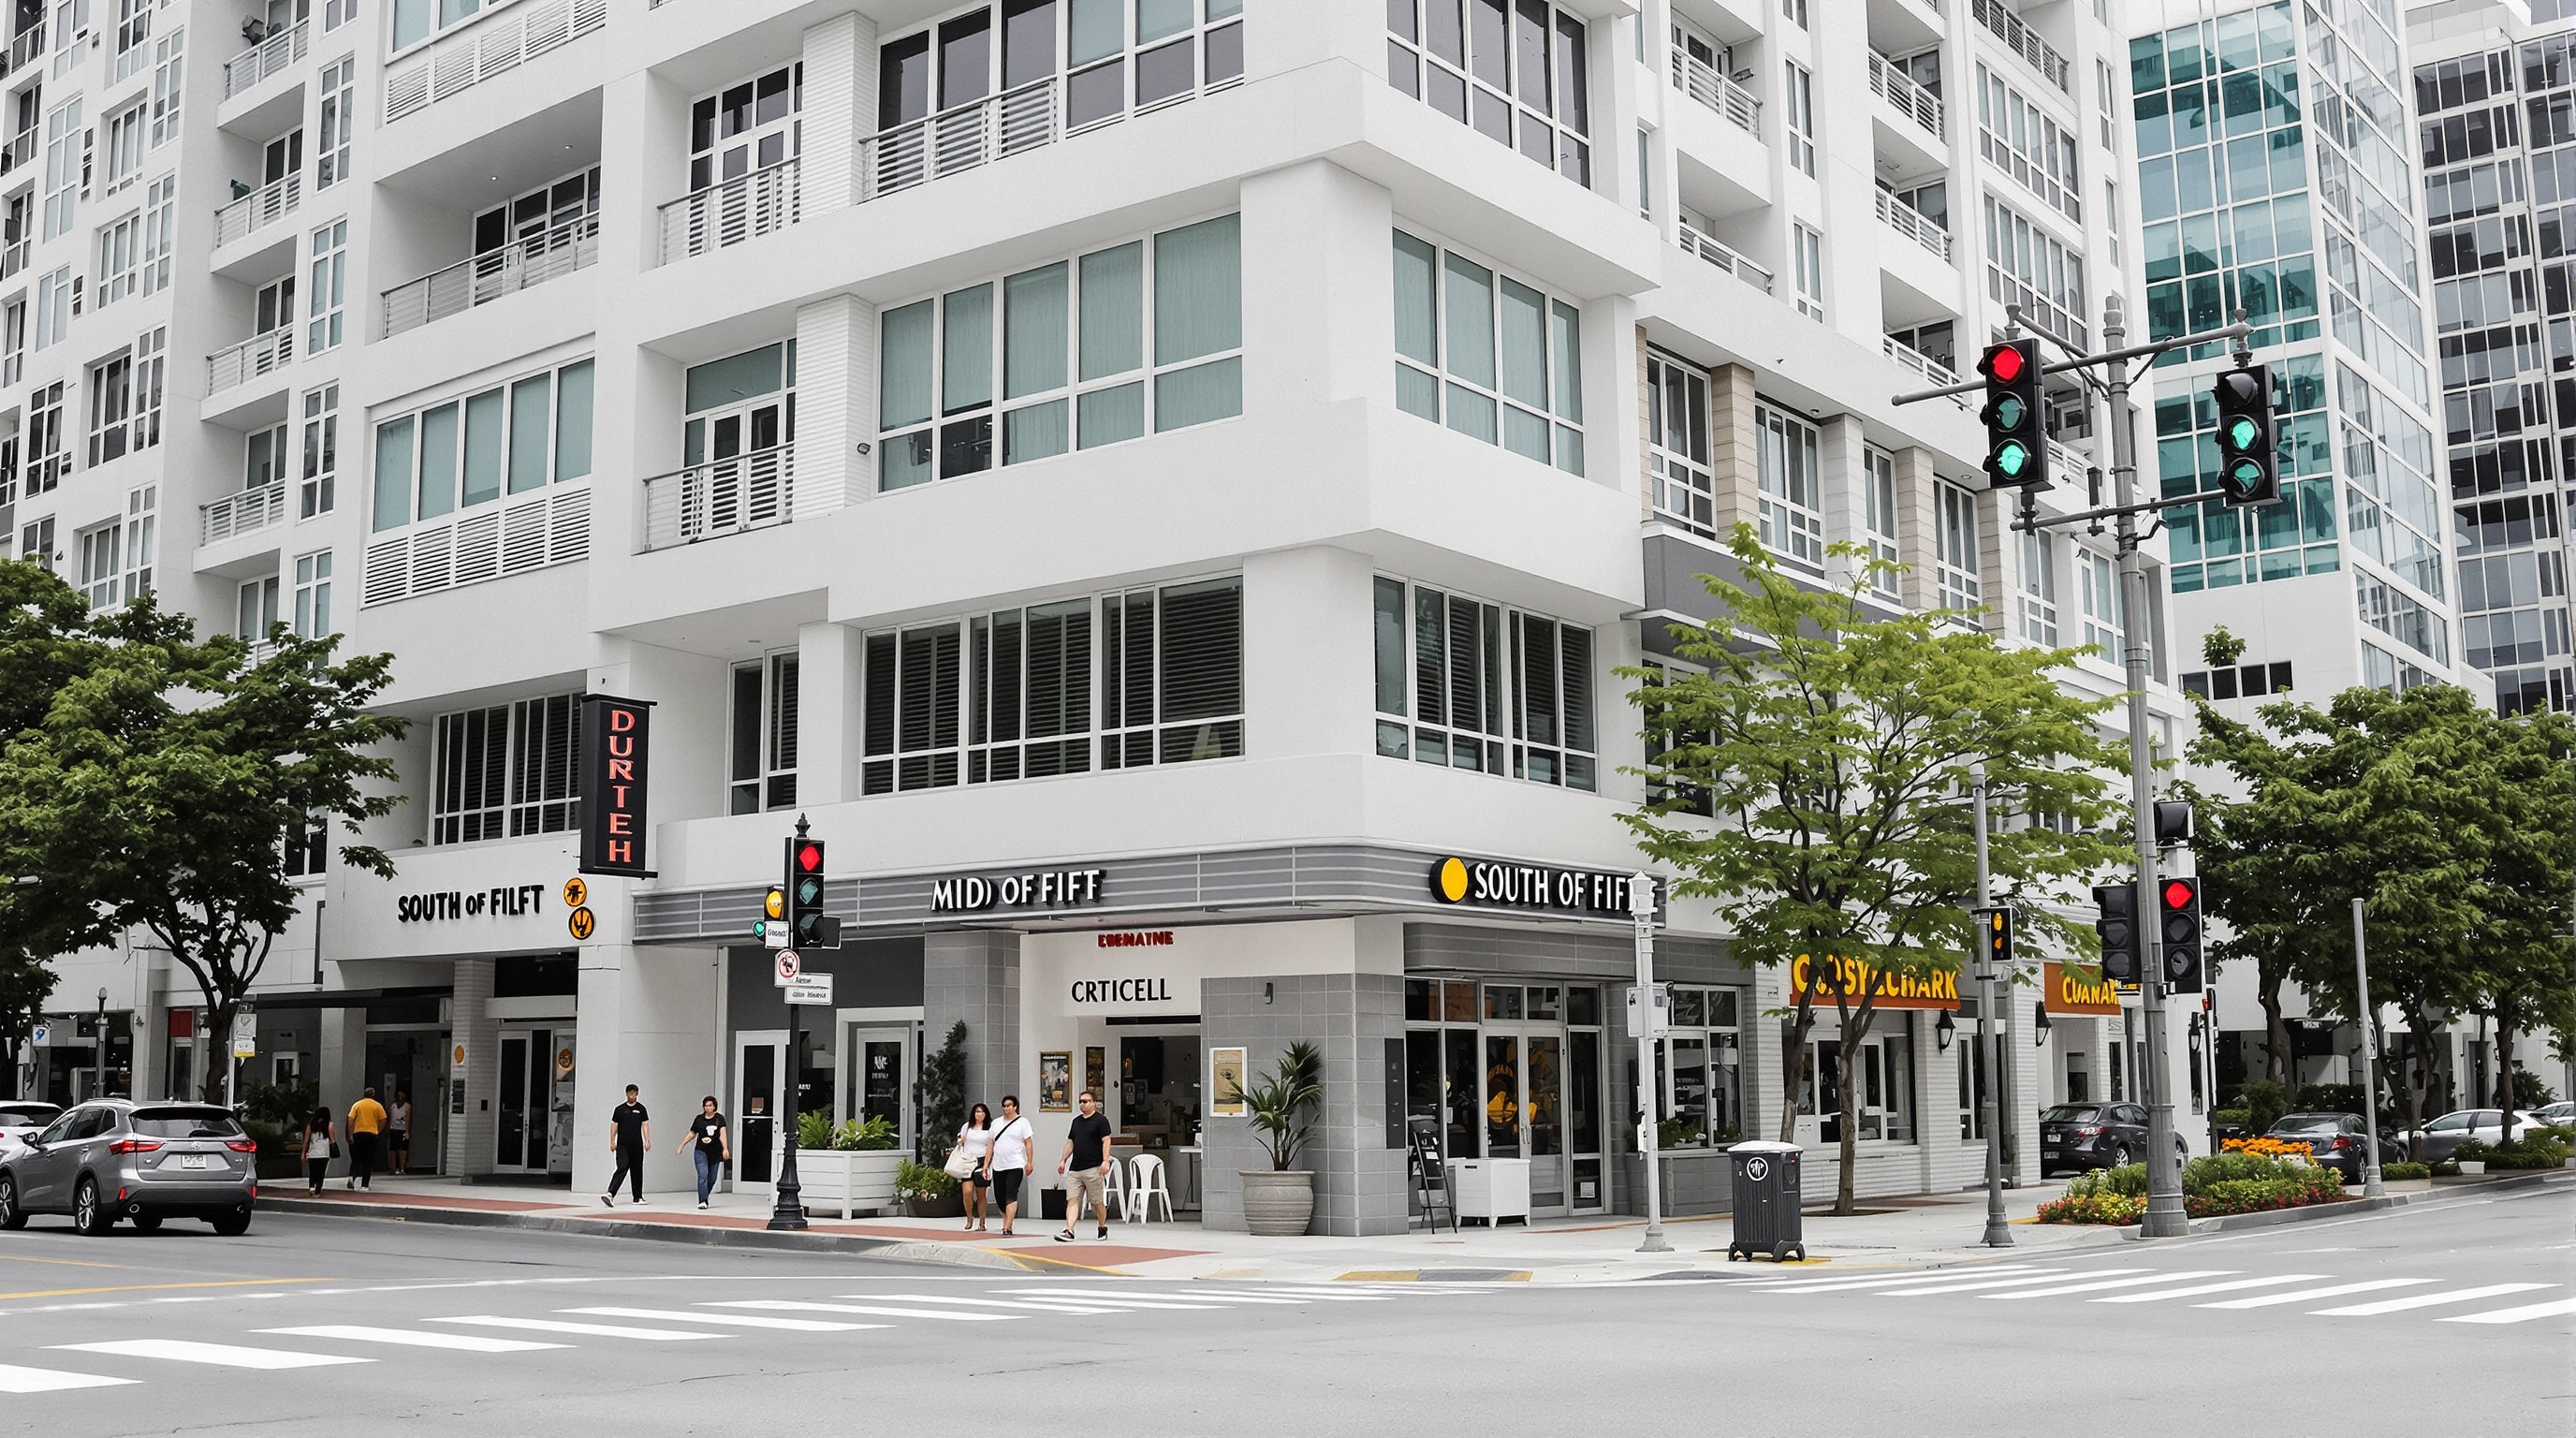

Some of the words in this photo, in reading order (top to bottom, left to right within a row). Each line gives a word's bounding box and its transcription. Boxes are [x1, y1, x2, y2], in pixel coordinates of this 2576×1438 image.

[1002, 874, 1035, 904] OF
[1041, 870, 1100, 902] FIFT
[1474, 862, 1549, 904] SOUTH
[1559, 872, 1586, 906] OF
[398, 891, 461, 923] SOUTH
[465, 892, 487, 916] OF
[490, 885, 545, 917] FILFT
[1071, 978, 1172, 1003] CRTICELL
